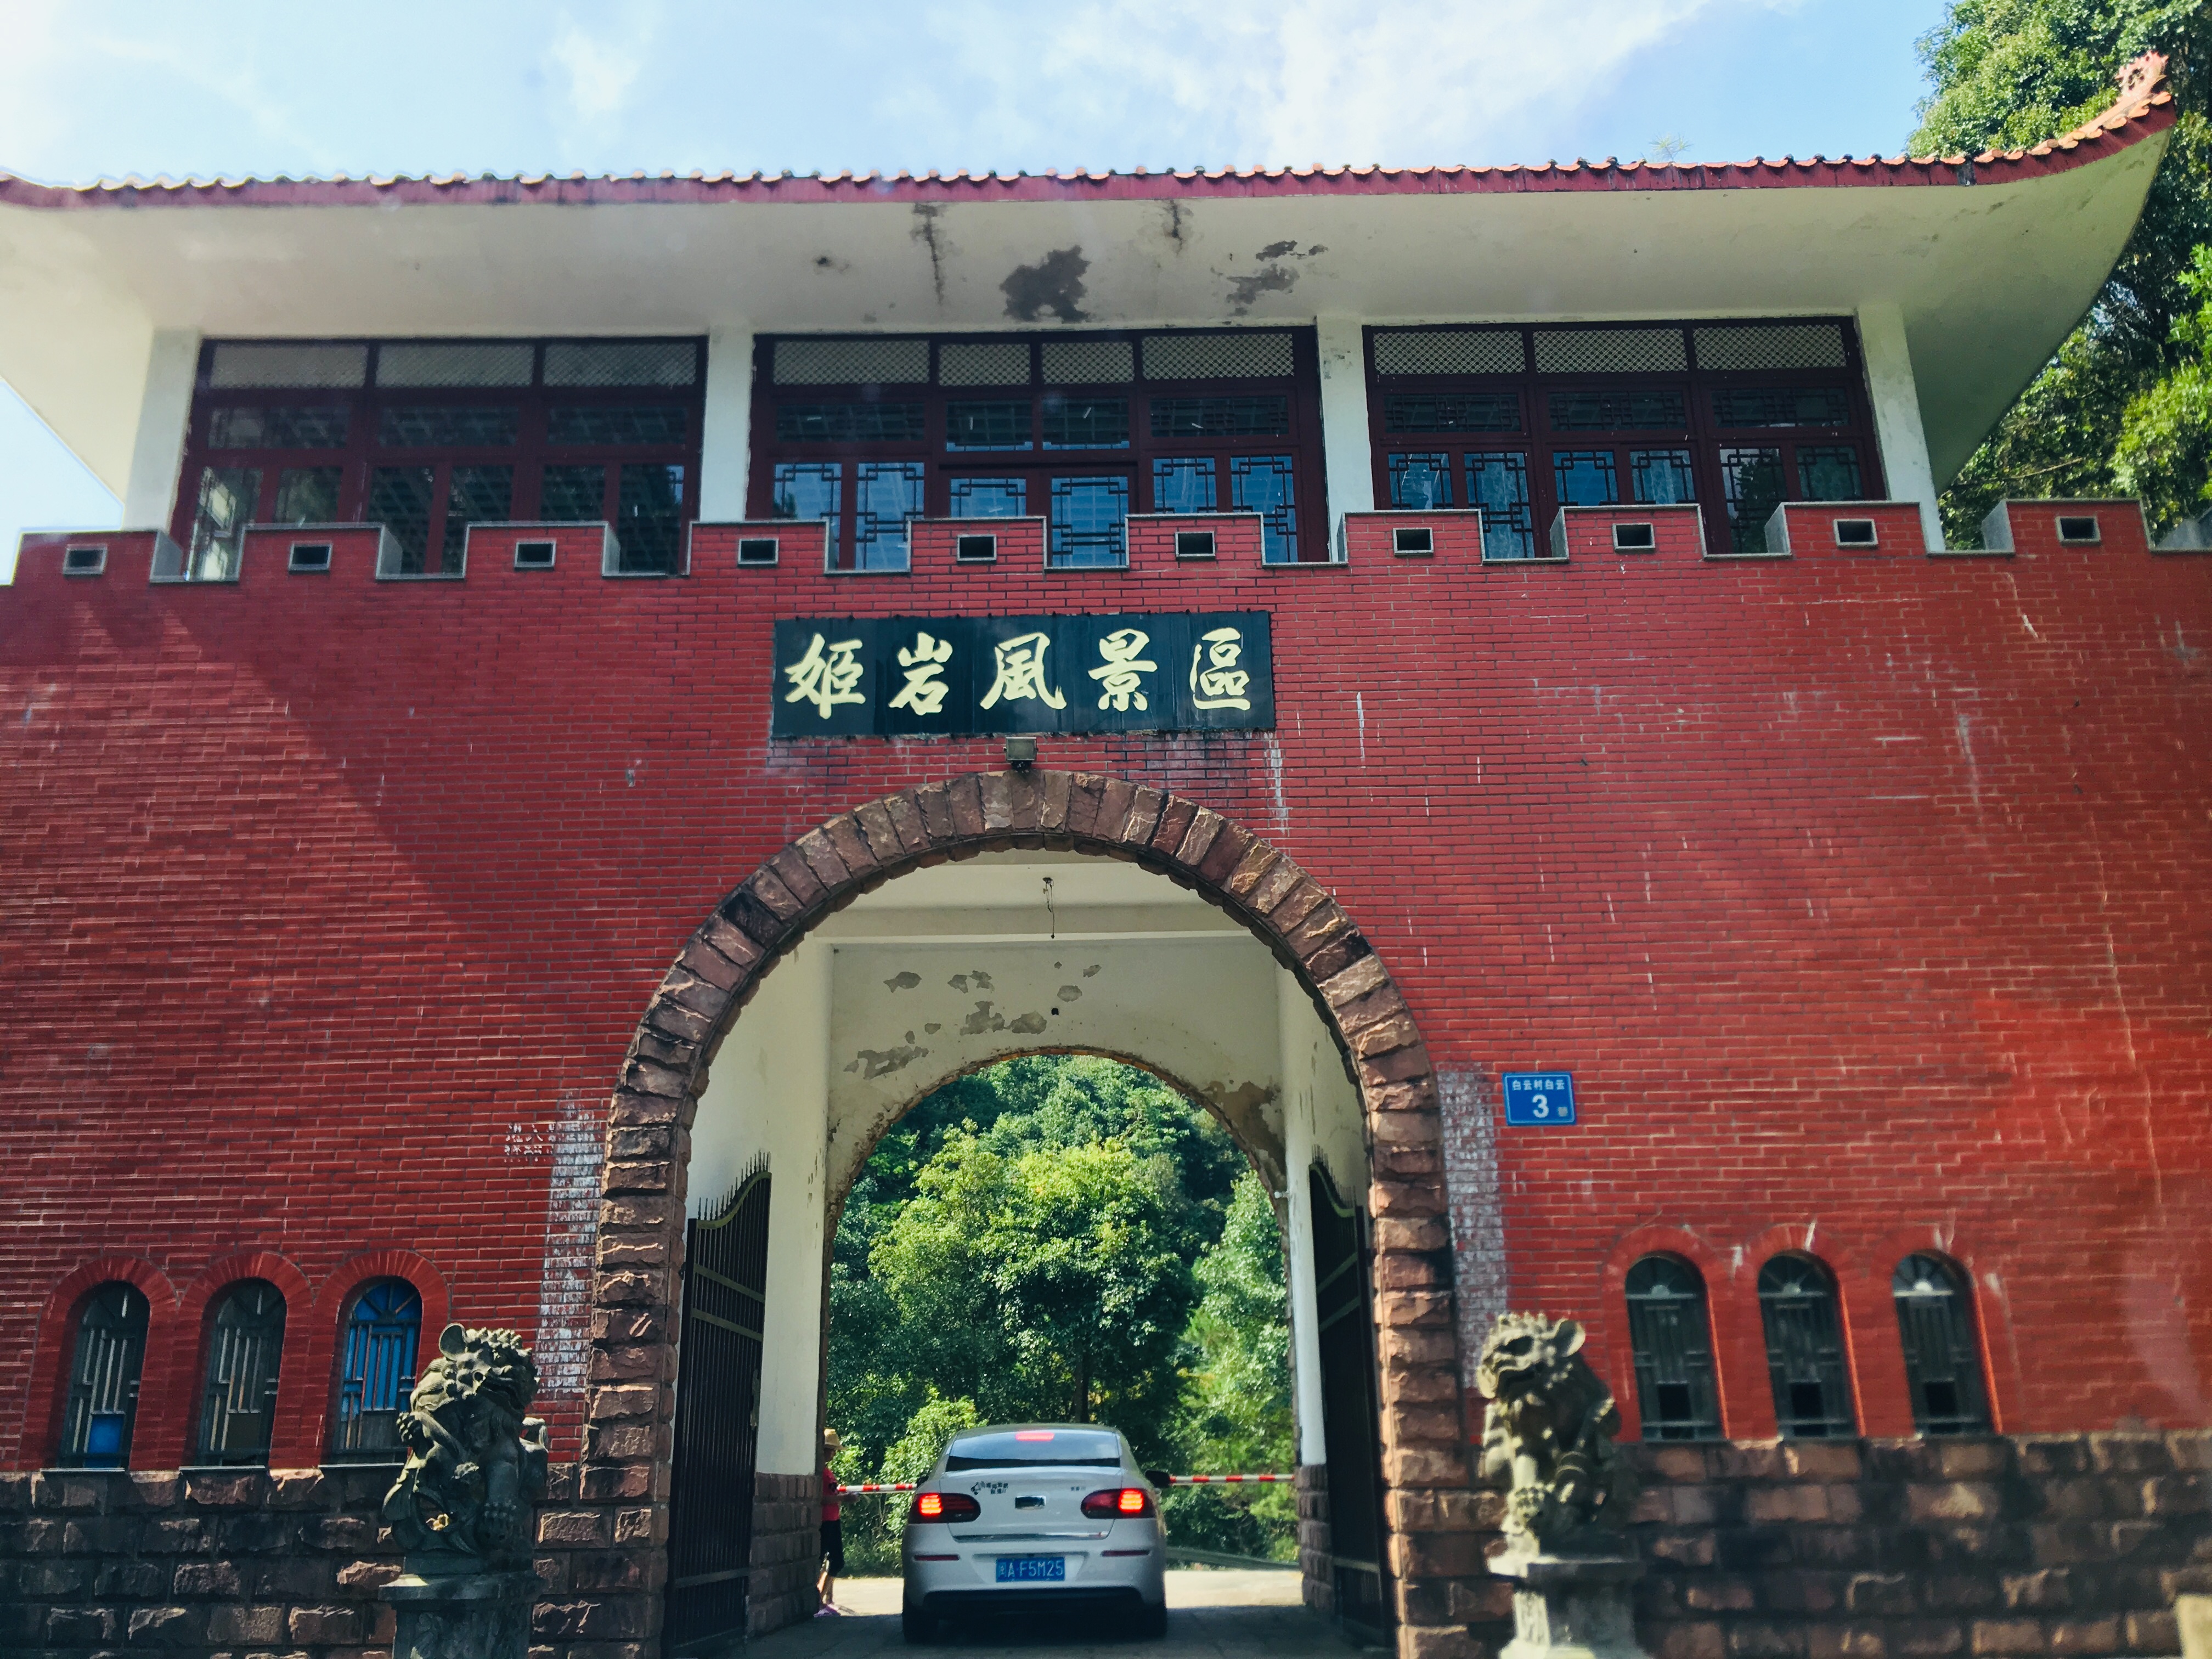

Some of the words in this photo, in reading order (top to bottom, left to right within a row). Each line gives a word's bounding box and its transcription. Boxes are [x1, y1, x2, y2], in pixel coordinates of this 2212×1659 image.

[784, 627, 1251, 719] 姬岩風景區
[1513, 1079, 1565, 1091] 白云村白云
[1532, 1094, 1549, 1118] 3
